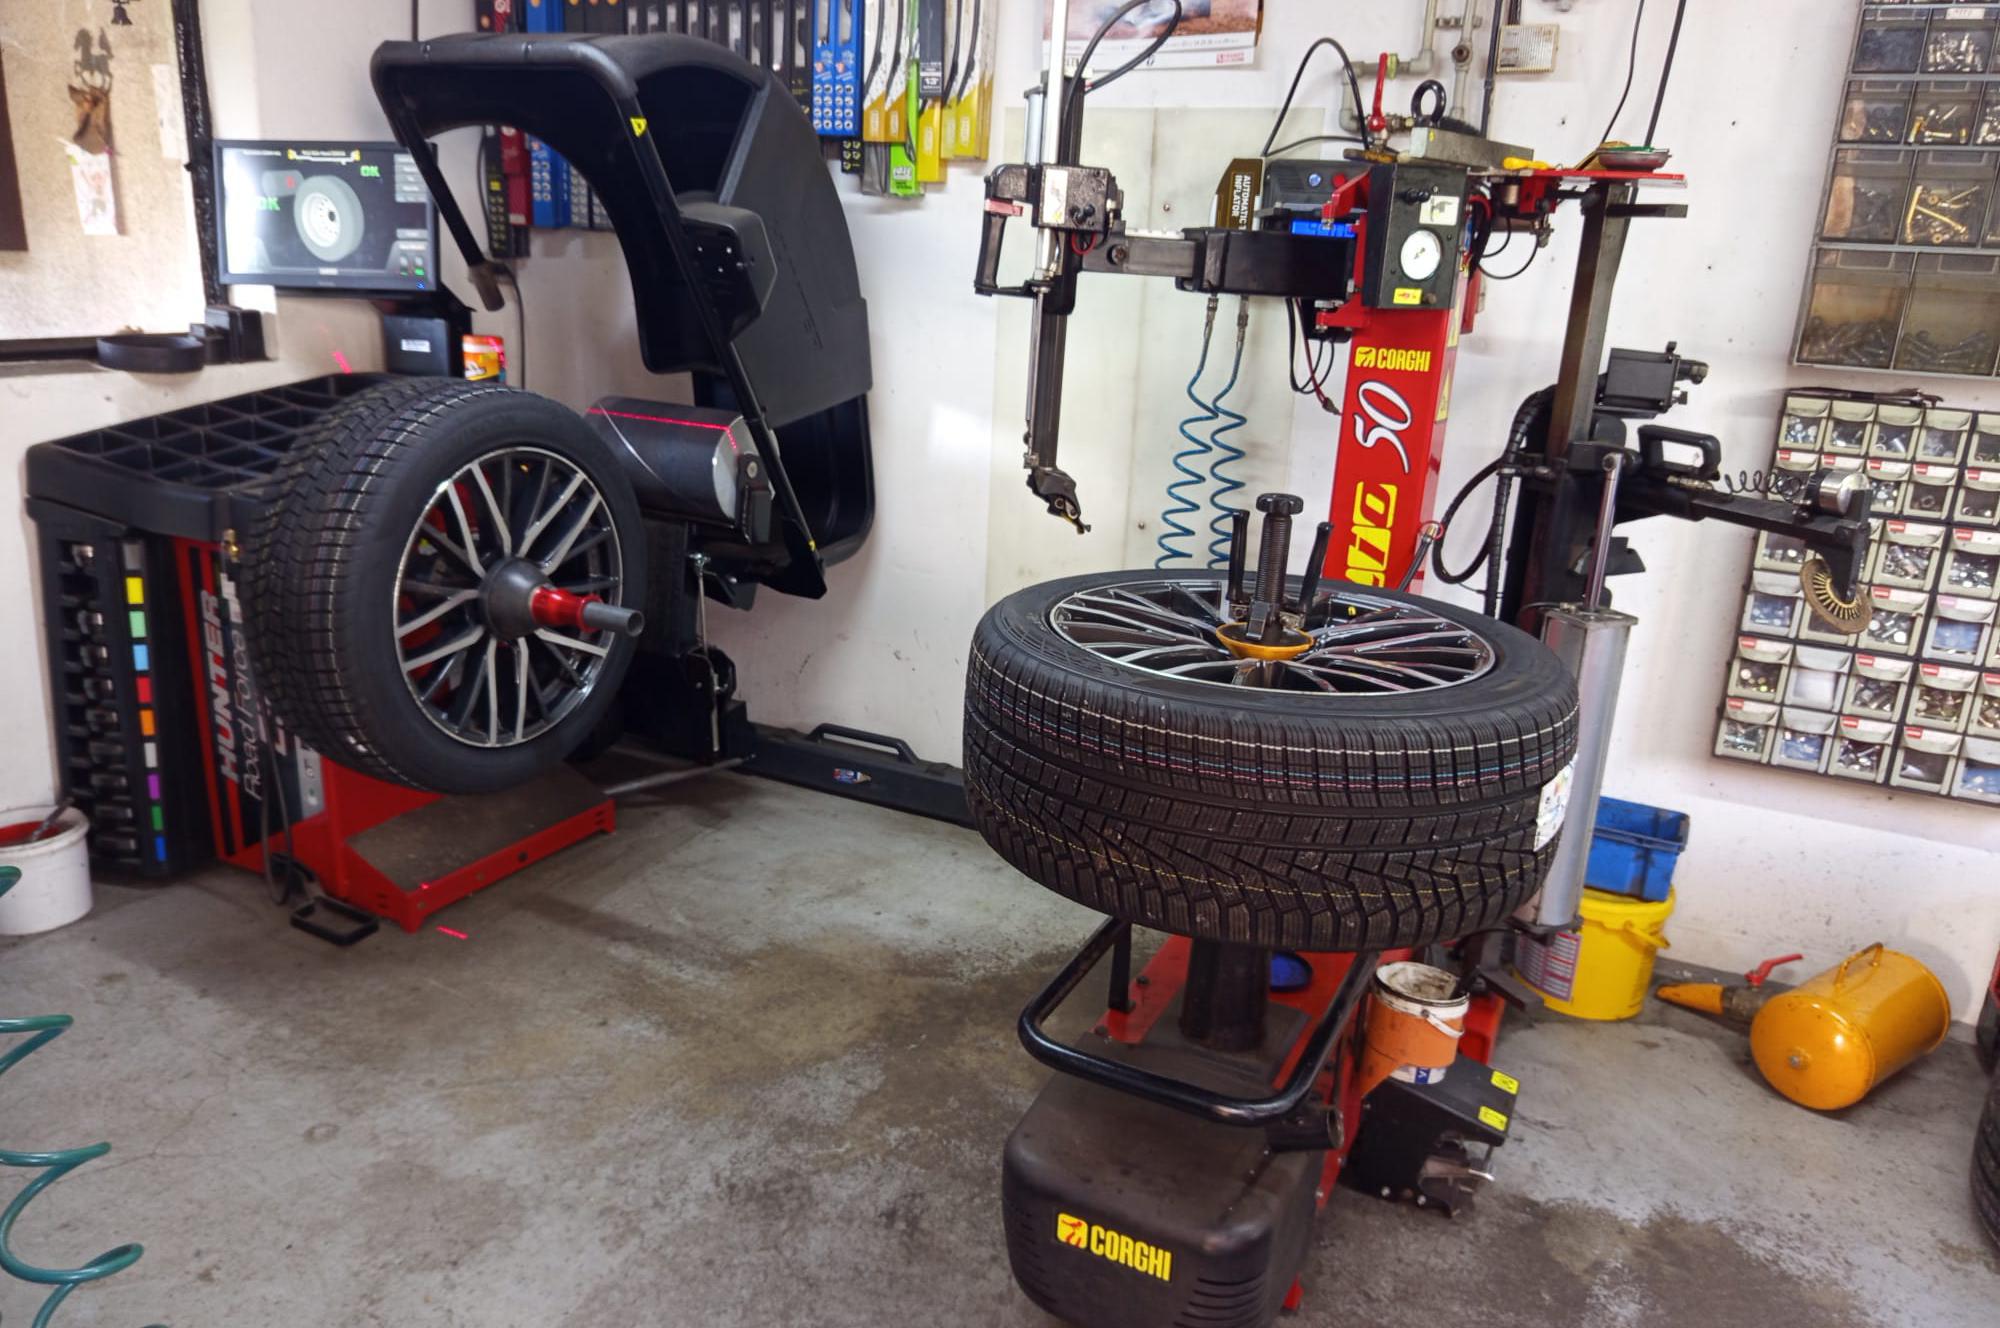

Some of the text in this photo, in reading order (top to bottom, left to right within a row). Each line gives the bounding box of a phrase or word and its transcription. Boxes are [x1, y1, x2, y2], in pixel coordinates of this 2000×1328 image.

[360, 166, 380, 177] OK
[1232, 175, 1242, 217] INFLATOR
[1239, 175, 1251, 224] AUTOMATIC
[1376, 350, 1431, 372] CORGHI
[1353, 381, 1412, 474] 50
[201, 590, 240, 784] HUNTER
[231, 629, 262, 800] Road Force
[1090, 1224, 1172, 1282] CORGHI
